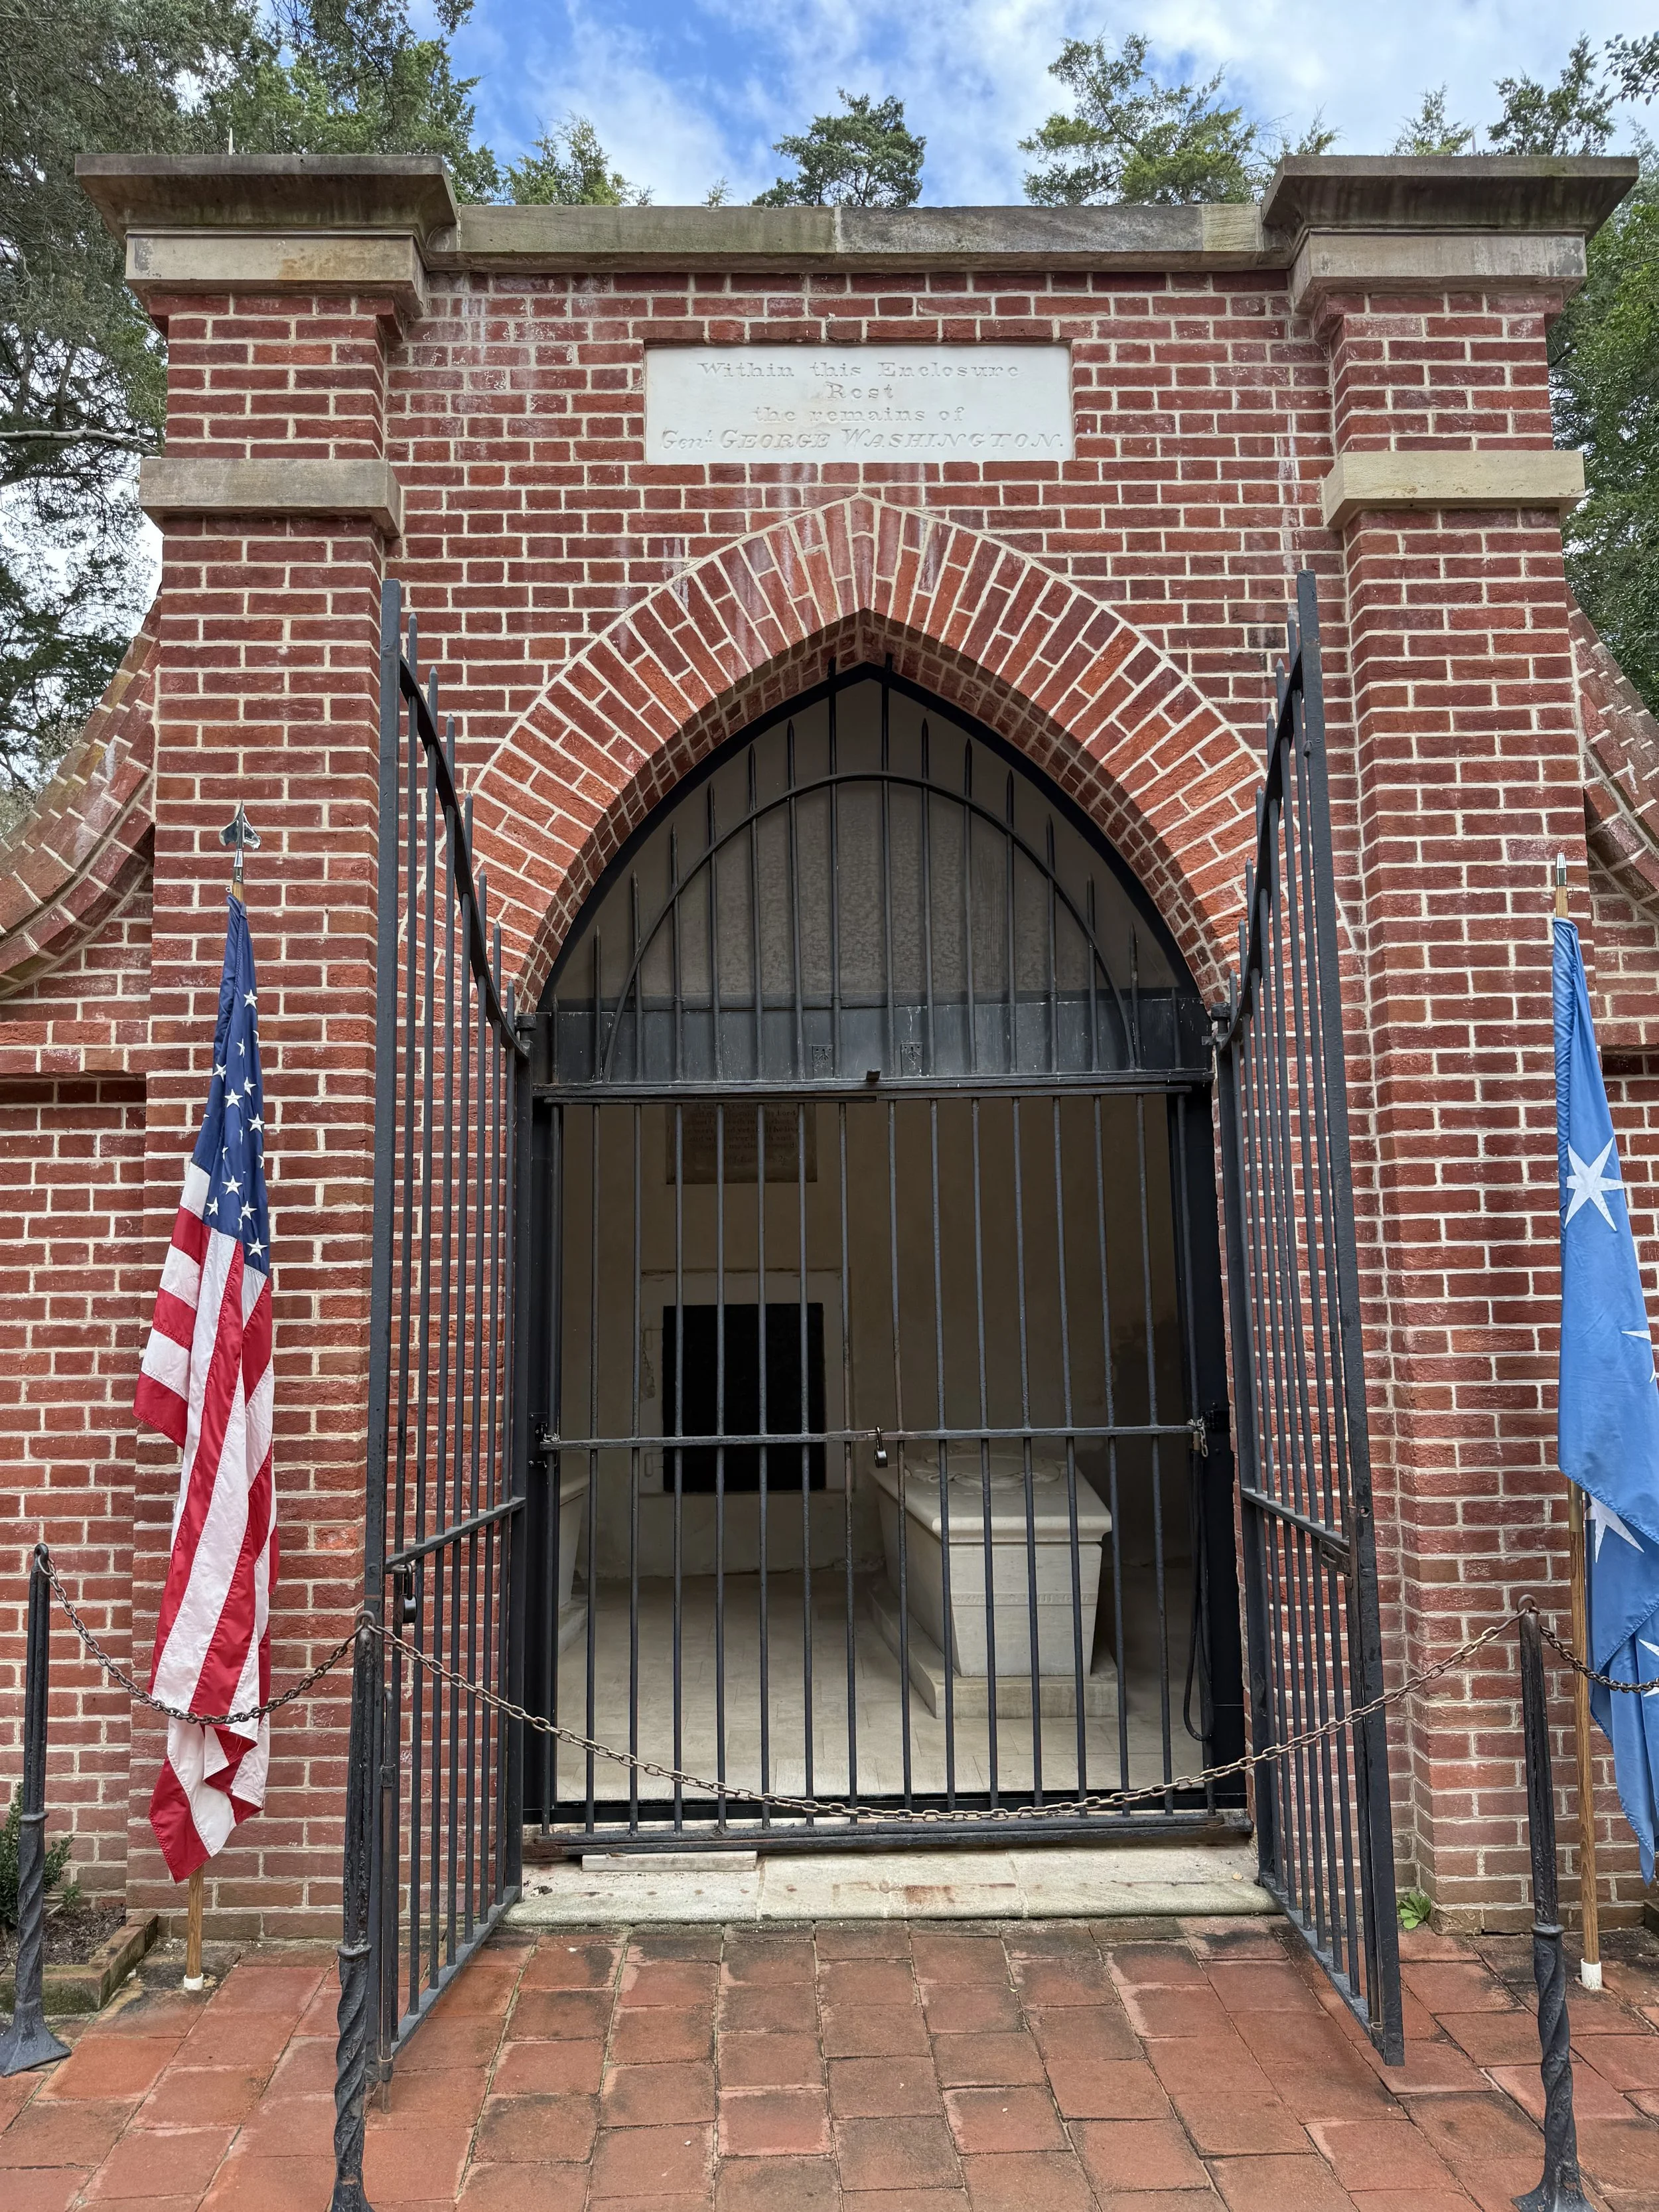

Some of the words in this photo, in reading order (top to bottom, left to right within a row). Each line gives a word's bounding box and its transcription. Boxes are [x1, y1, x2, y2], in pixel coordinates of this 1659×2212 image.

[697, 362, 795, 378] Within
[810, 362, 862, 378] this
[877, 362, 1021, 378] Enclosure
[826, 381, 894, 399] Rest
[753, 406, 796, 422] the
[810, 407, 926, 423] remains
[938, 406, 965, 421] of
